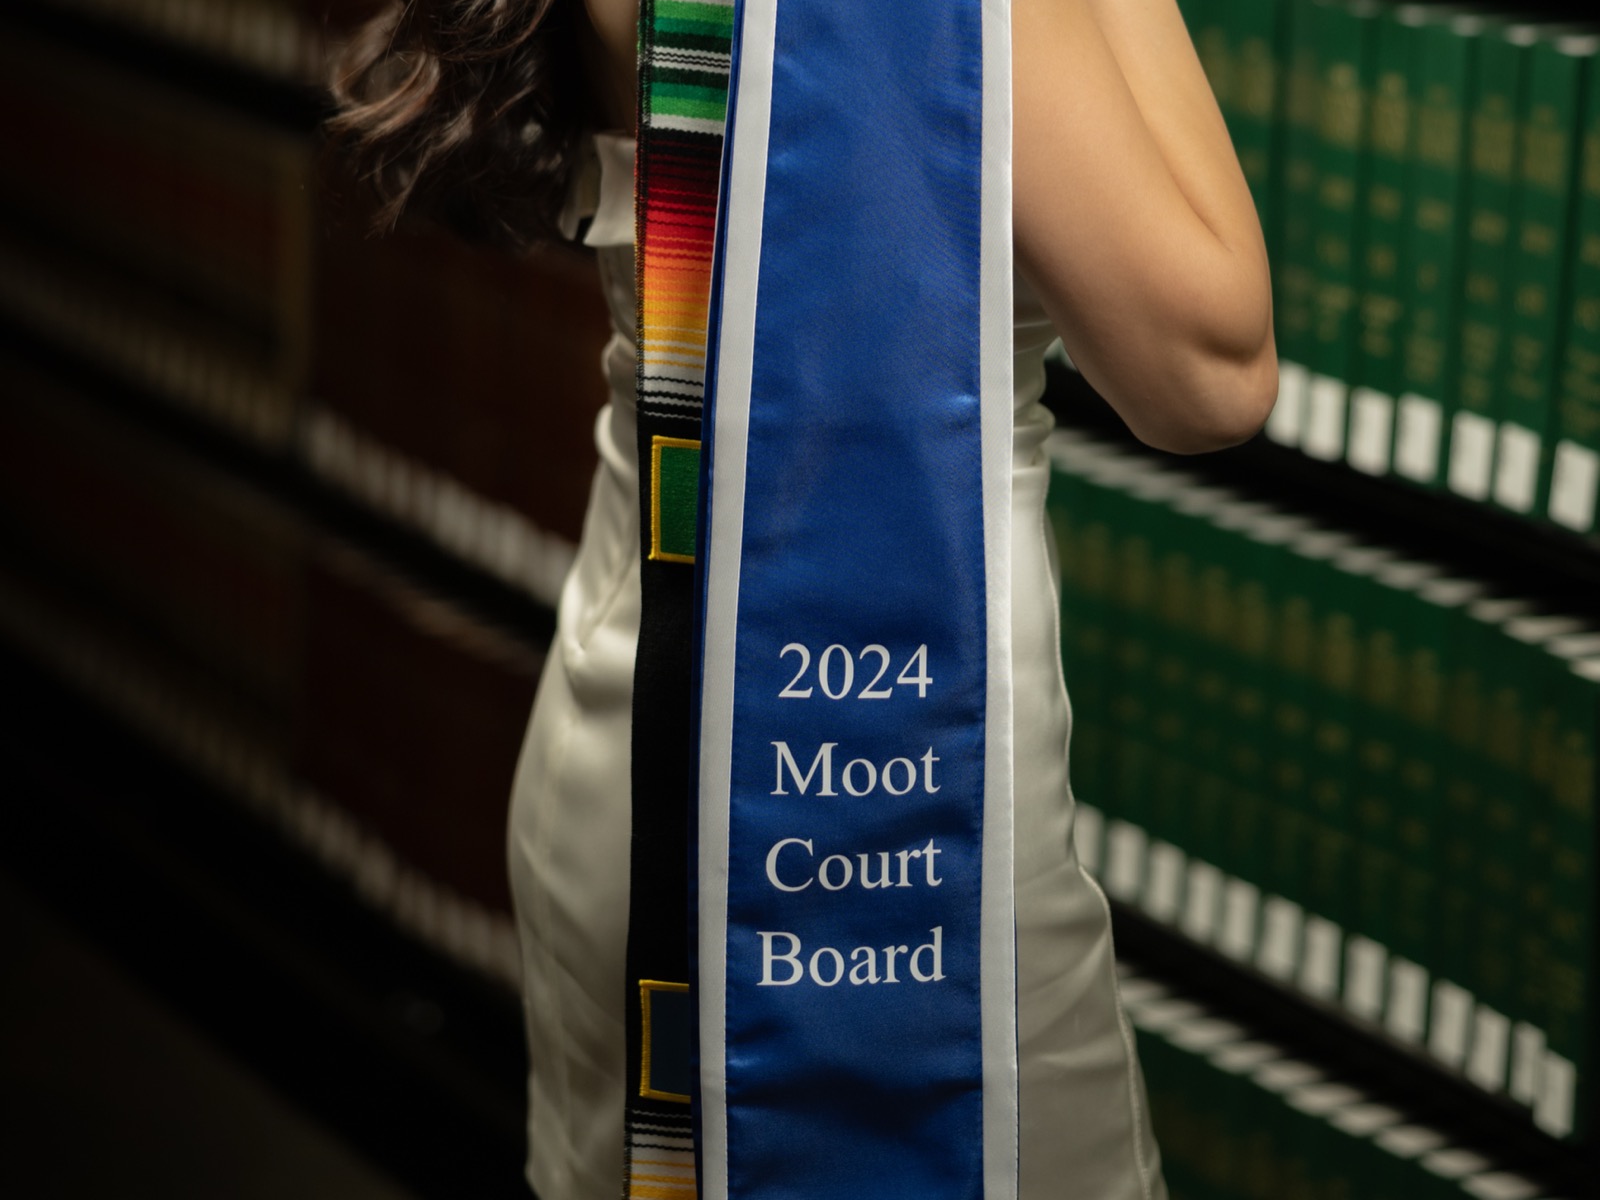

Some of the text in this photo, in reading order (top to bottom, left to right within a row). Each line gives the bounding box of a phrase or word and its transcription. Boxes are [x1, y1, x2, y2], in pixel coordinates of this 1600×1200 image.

[779, 643, 933, 699] 2024
[770, 741, 941, 796] Moot
[765, 838, 942, 891] Court
[756, 926, 946, 986] Board
